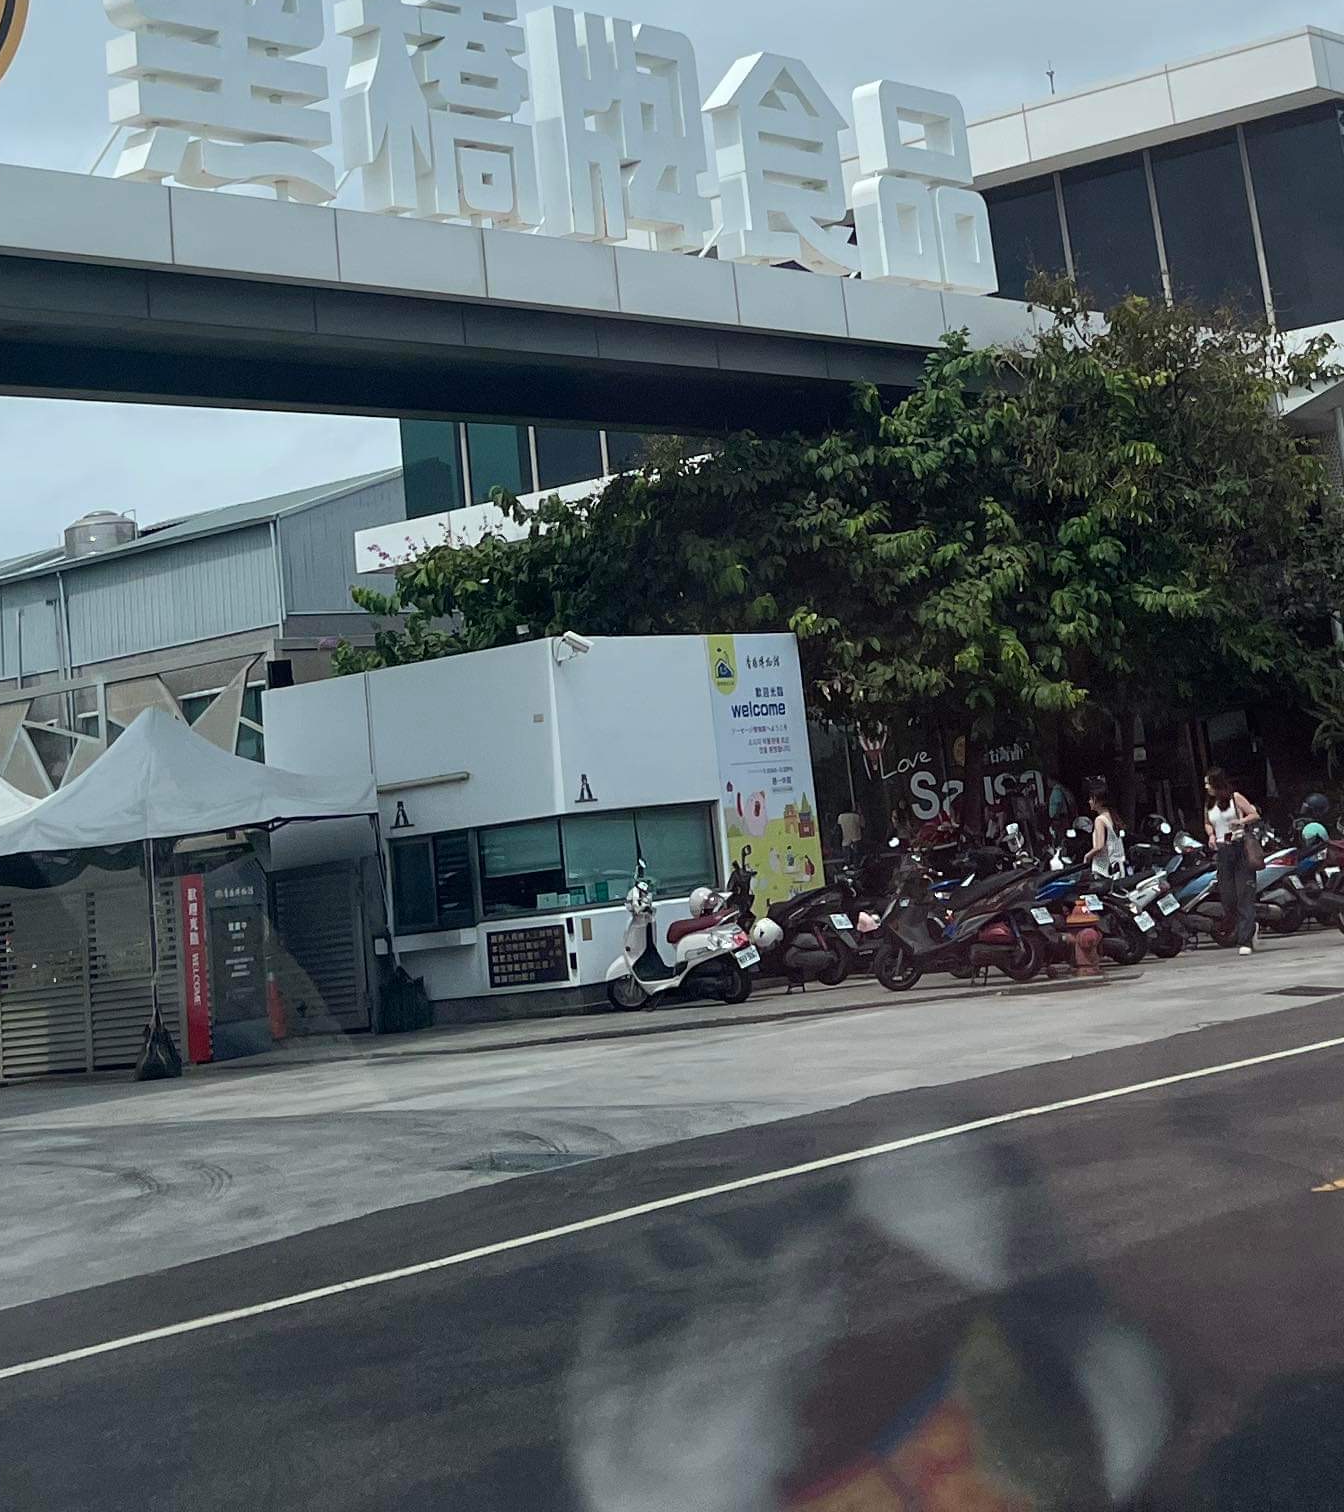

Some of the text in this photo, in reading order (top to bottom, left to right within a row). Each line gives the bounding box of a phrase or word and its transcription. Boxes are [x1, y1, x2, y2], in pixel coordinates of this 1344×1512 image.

[731, 701, 786, 718] welcome
[879, 751, 933, 780] Love
[192, 953, 202, 1007] WELCOME
